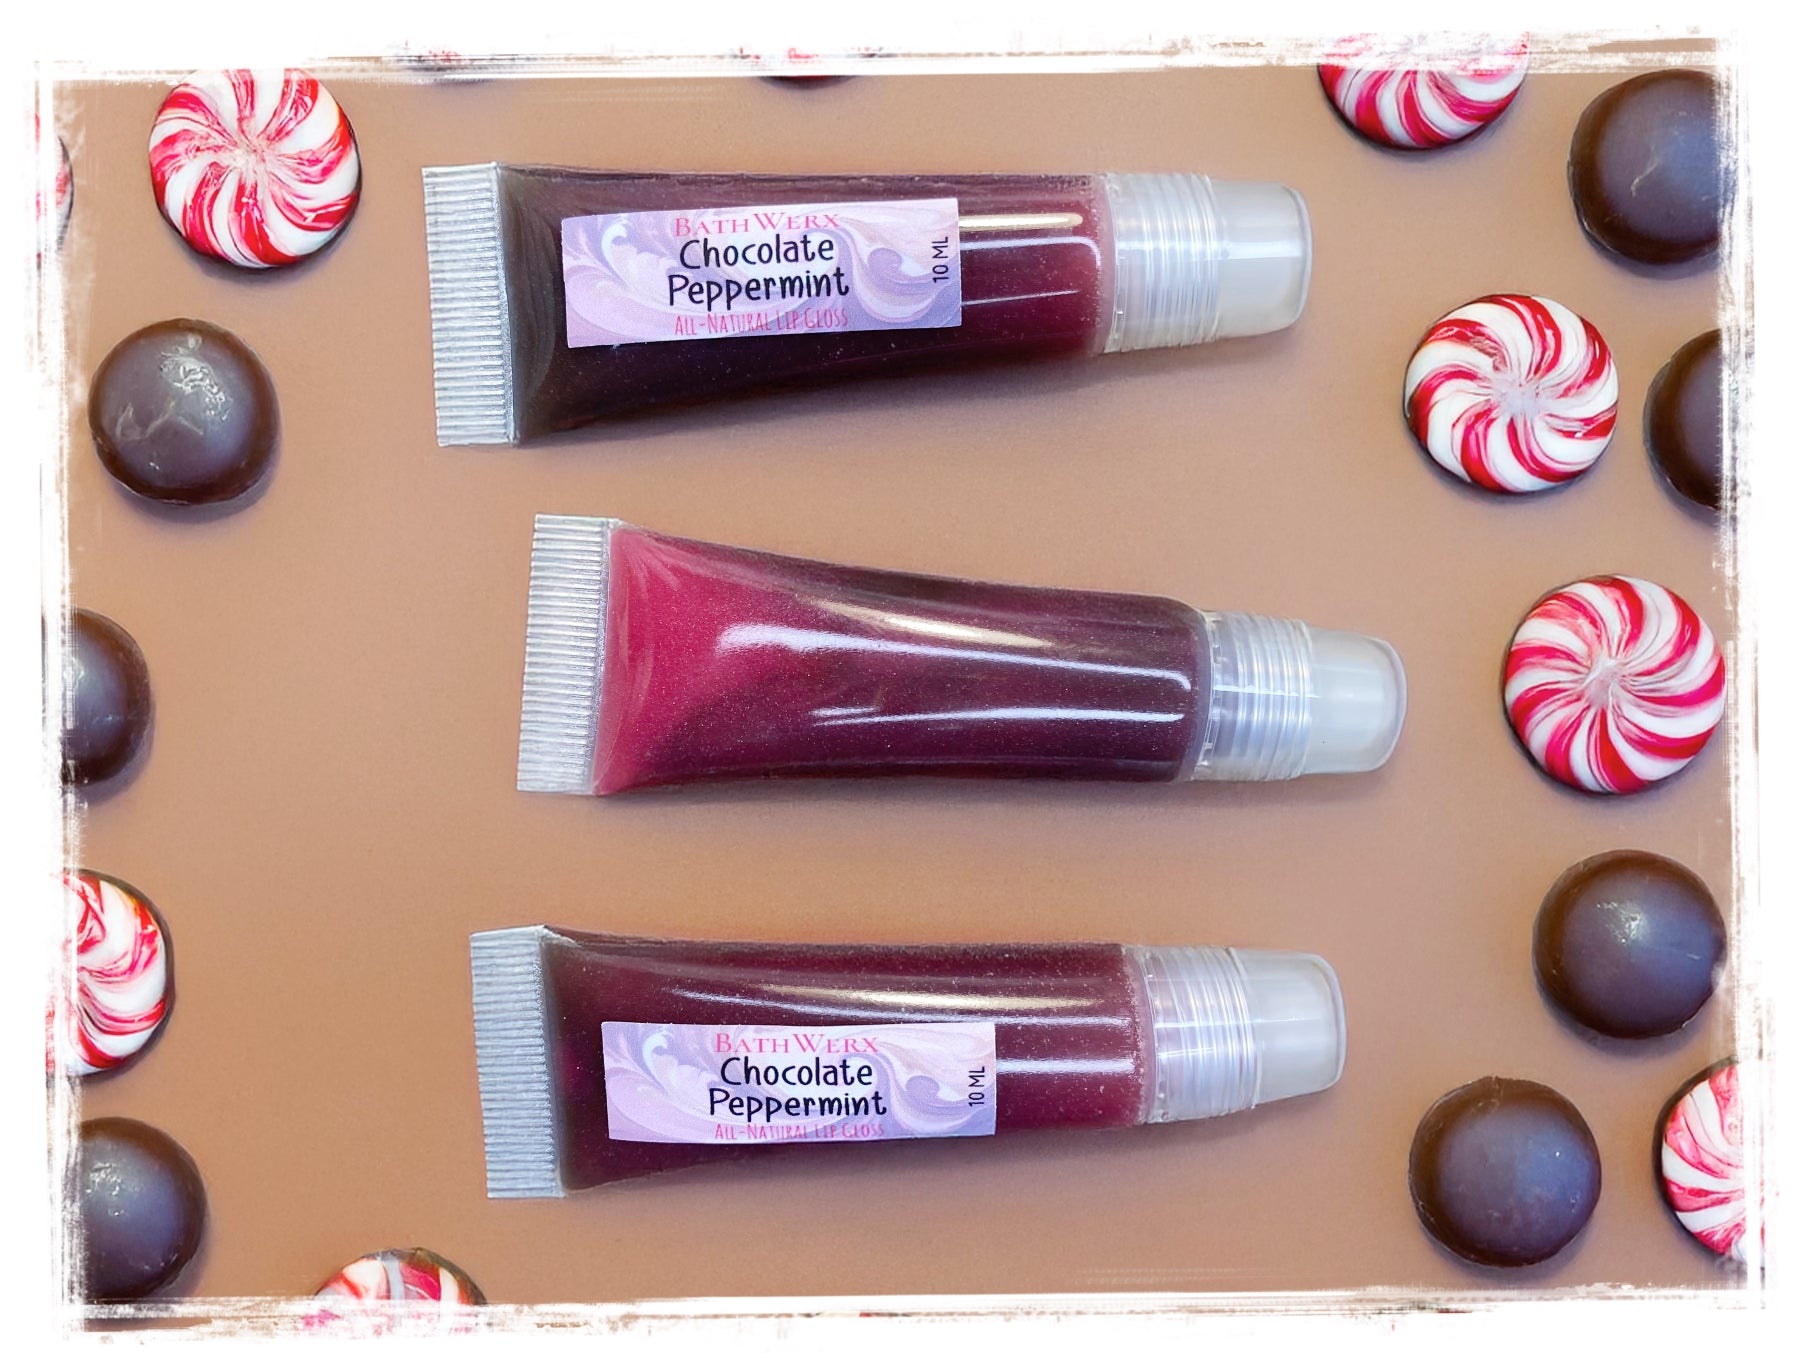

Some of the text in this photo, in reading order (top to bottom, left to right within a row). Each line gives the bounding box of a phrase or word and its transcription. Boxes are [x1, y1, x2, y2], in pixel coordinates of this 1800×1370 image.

[679, 233, 834, 270] Chocolate
[931, 236, 950, 284] 10 ML
[668, 266, 849, 312] Peppermint
[675, 307, 849, 336] ALL-NATURAL LIP GLOSS
[720, 1056, 873, 1086] Chocolate
[968, 1066, 985, 1107] 10 ML
[709, 1087, 887, 1123] Peppermint
[715, 1122, 885, 1140] ALL-NATURAL LIP GLOSS
